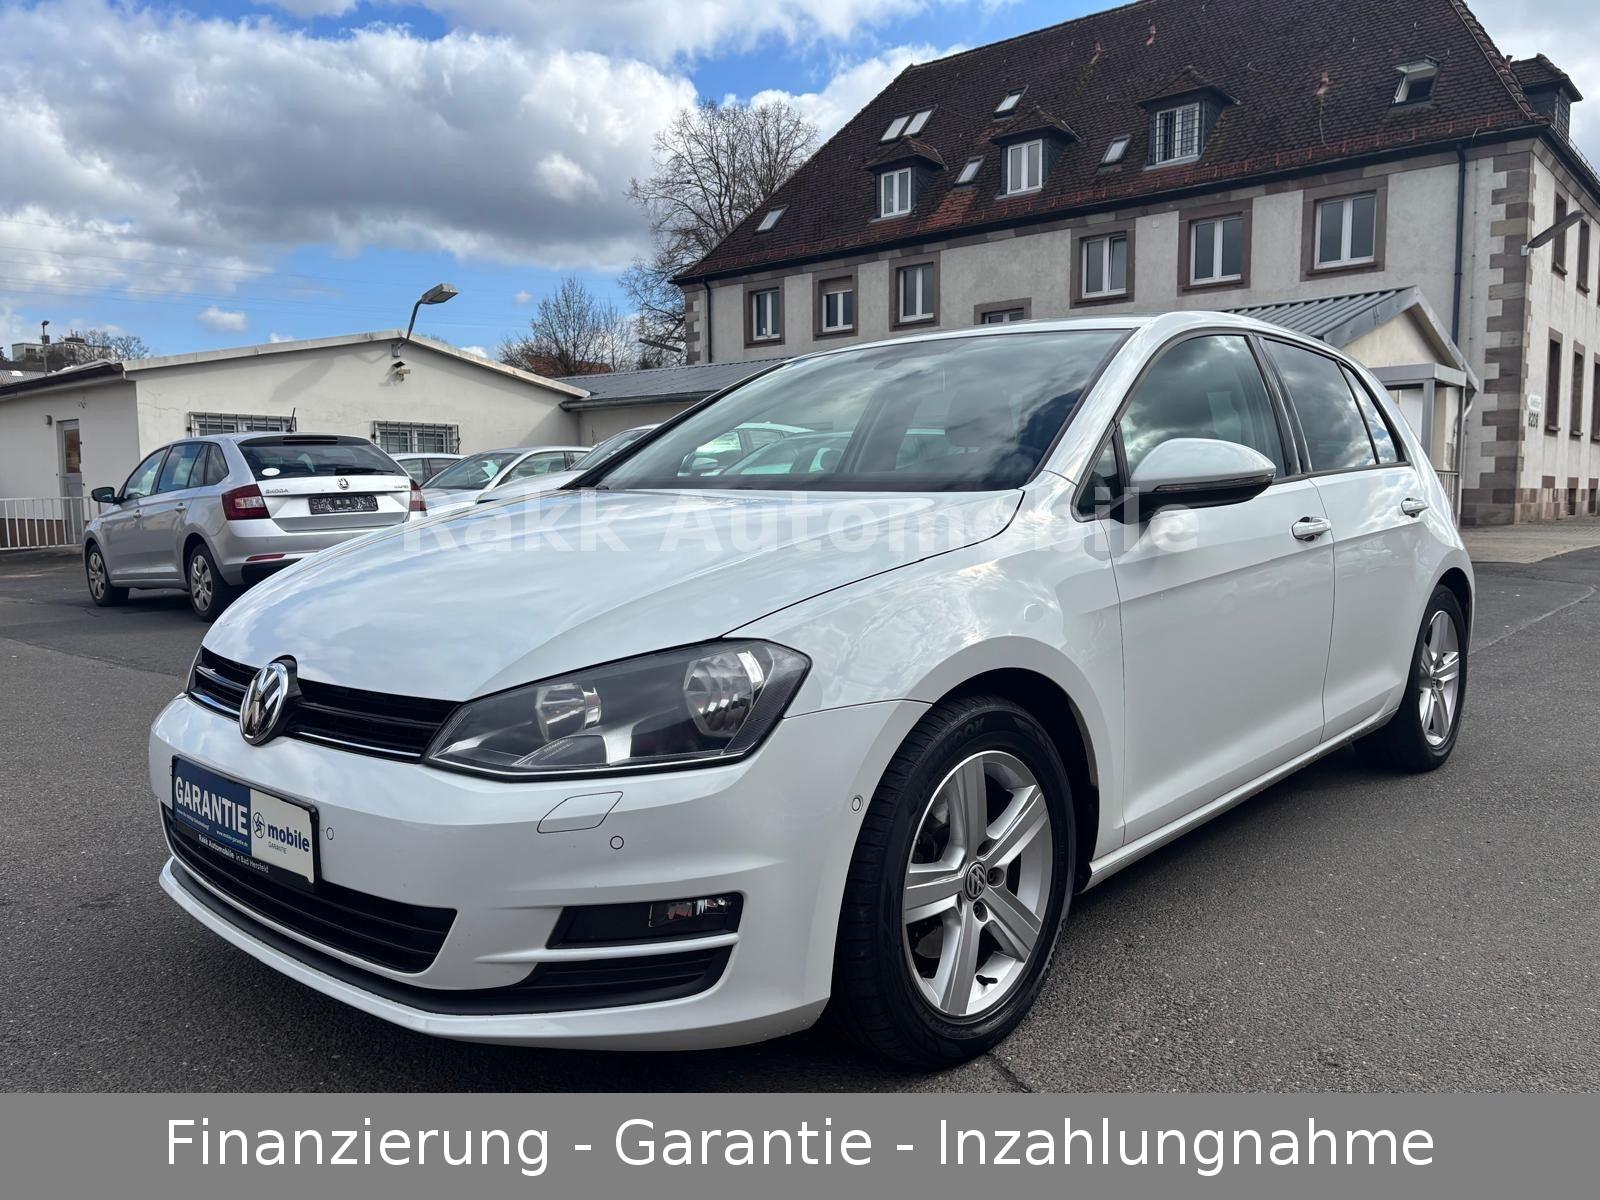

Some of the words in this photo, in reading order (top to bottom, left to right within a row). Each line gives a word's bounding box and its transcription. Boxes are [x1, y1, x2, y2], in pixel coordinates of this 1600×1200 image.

[175, 776, 248, 836] GARANTIE
[267, 823, 310, 852] mobile
[267, 841, 288, 855] GARANTIE
[209, 840, 235, 859] Automobile
[235, 853, 241, 862] in
[241, 855, 250, 866] Bad
